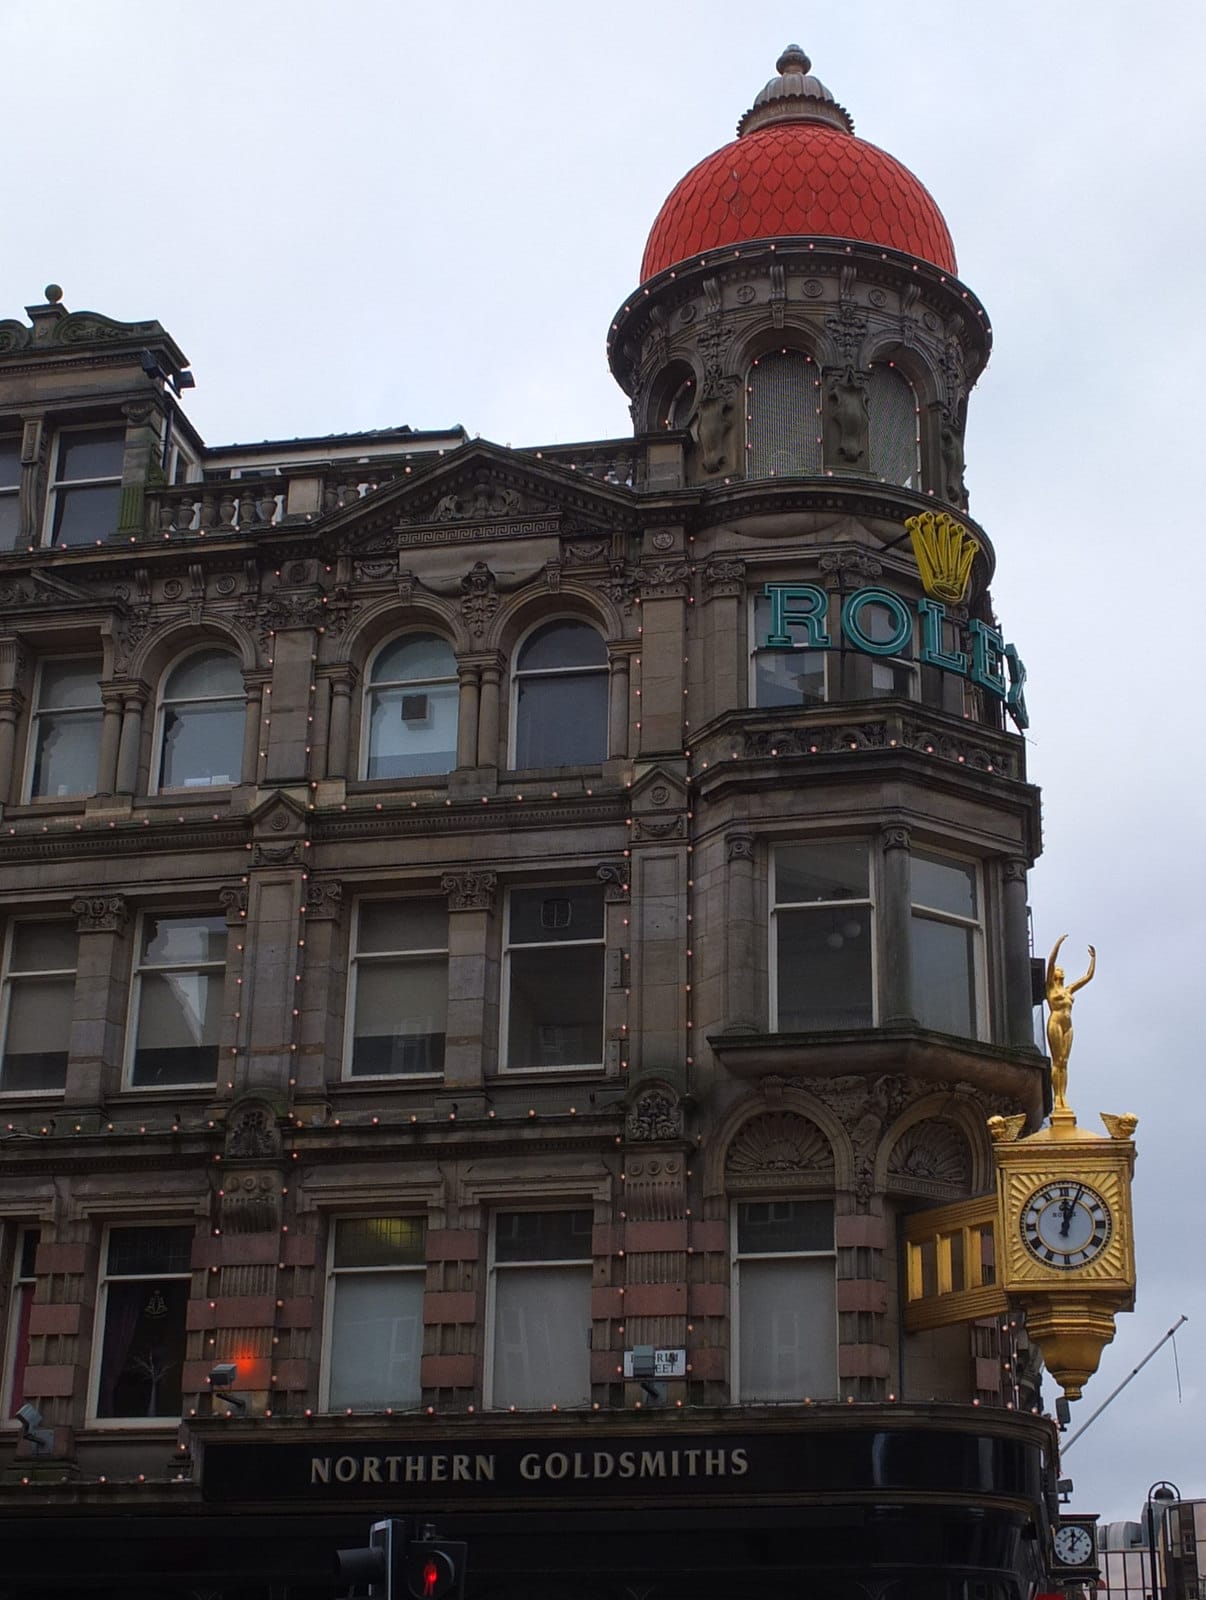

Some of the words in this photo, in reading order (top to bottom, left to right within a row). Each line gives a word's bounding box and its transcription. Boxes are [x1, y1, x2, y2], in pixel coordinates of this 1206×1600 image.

[765, 583, 1029, 729] ROLEX
[311, 1455, 496, 1483] NORTHERN
[519, 1449, 749, 1480] GOLDSMITHS
